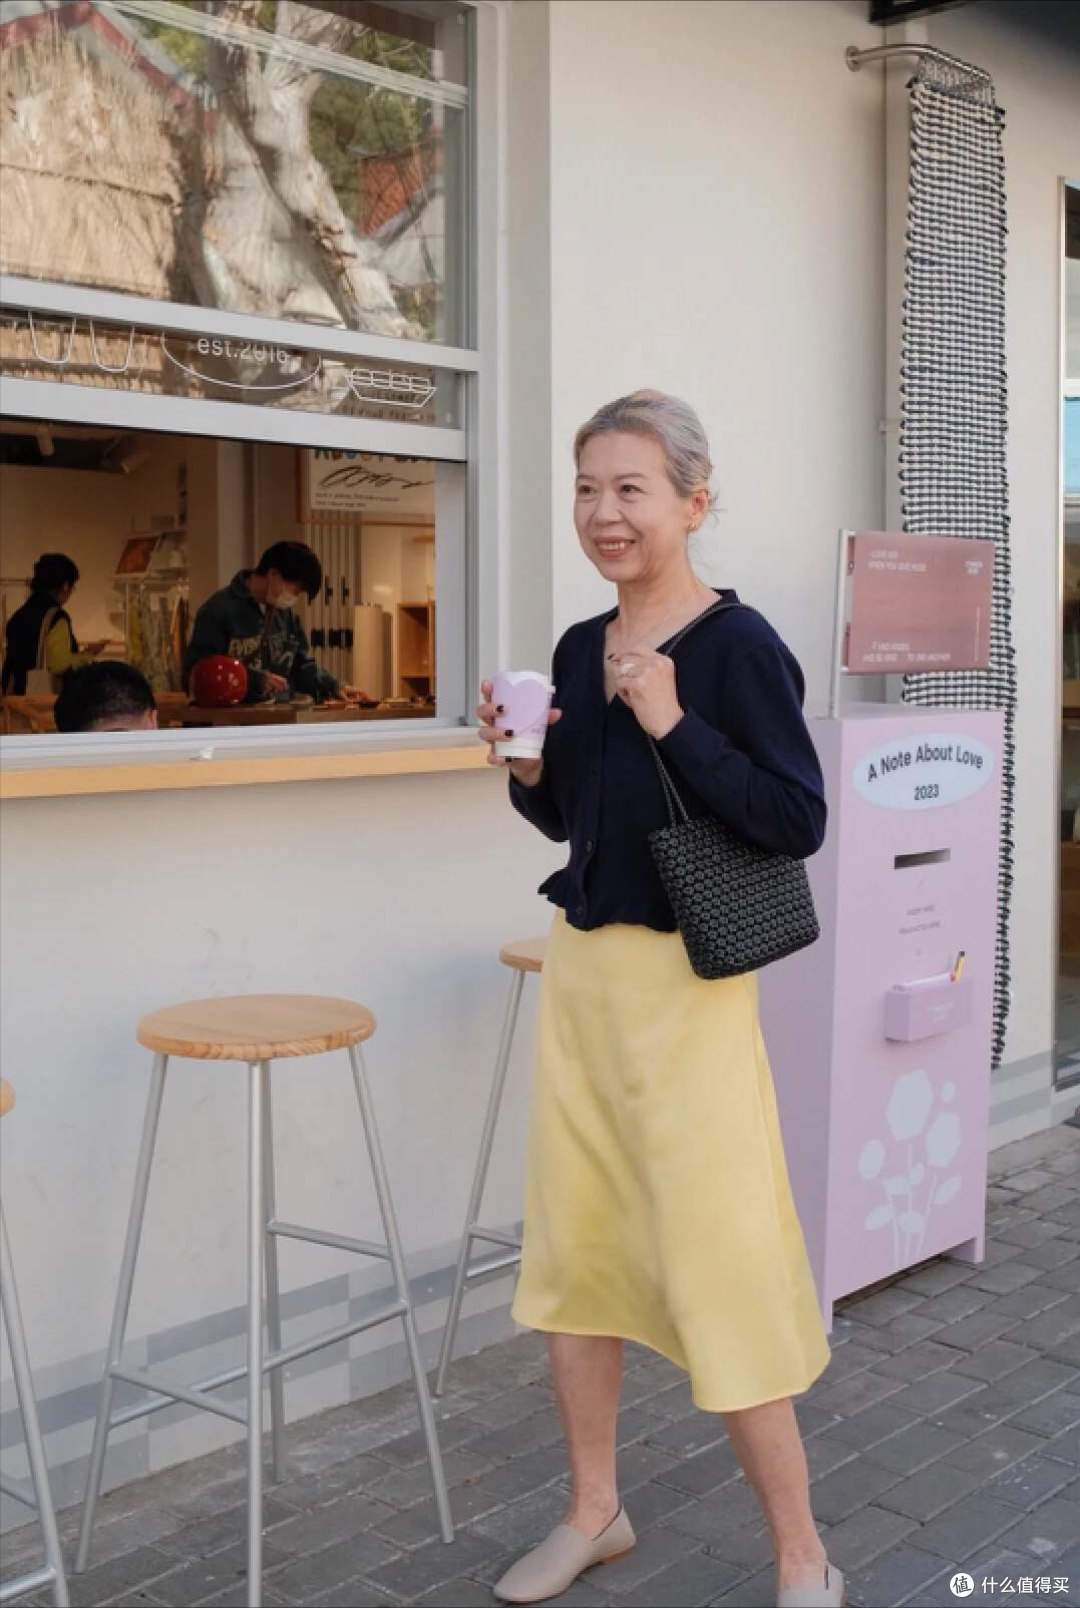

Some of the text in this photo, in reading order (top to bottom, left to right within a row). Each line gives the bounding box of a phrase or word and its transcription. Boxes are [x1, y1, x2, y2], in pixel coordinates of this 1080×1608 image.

[198, 338, 287, 363] est.2016
[868, 743, 983, 782] A Note About Love
[914, 784, 939, 801] 2023
